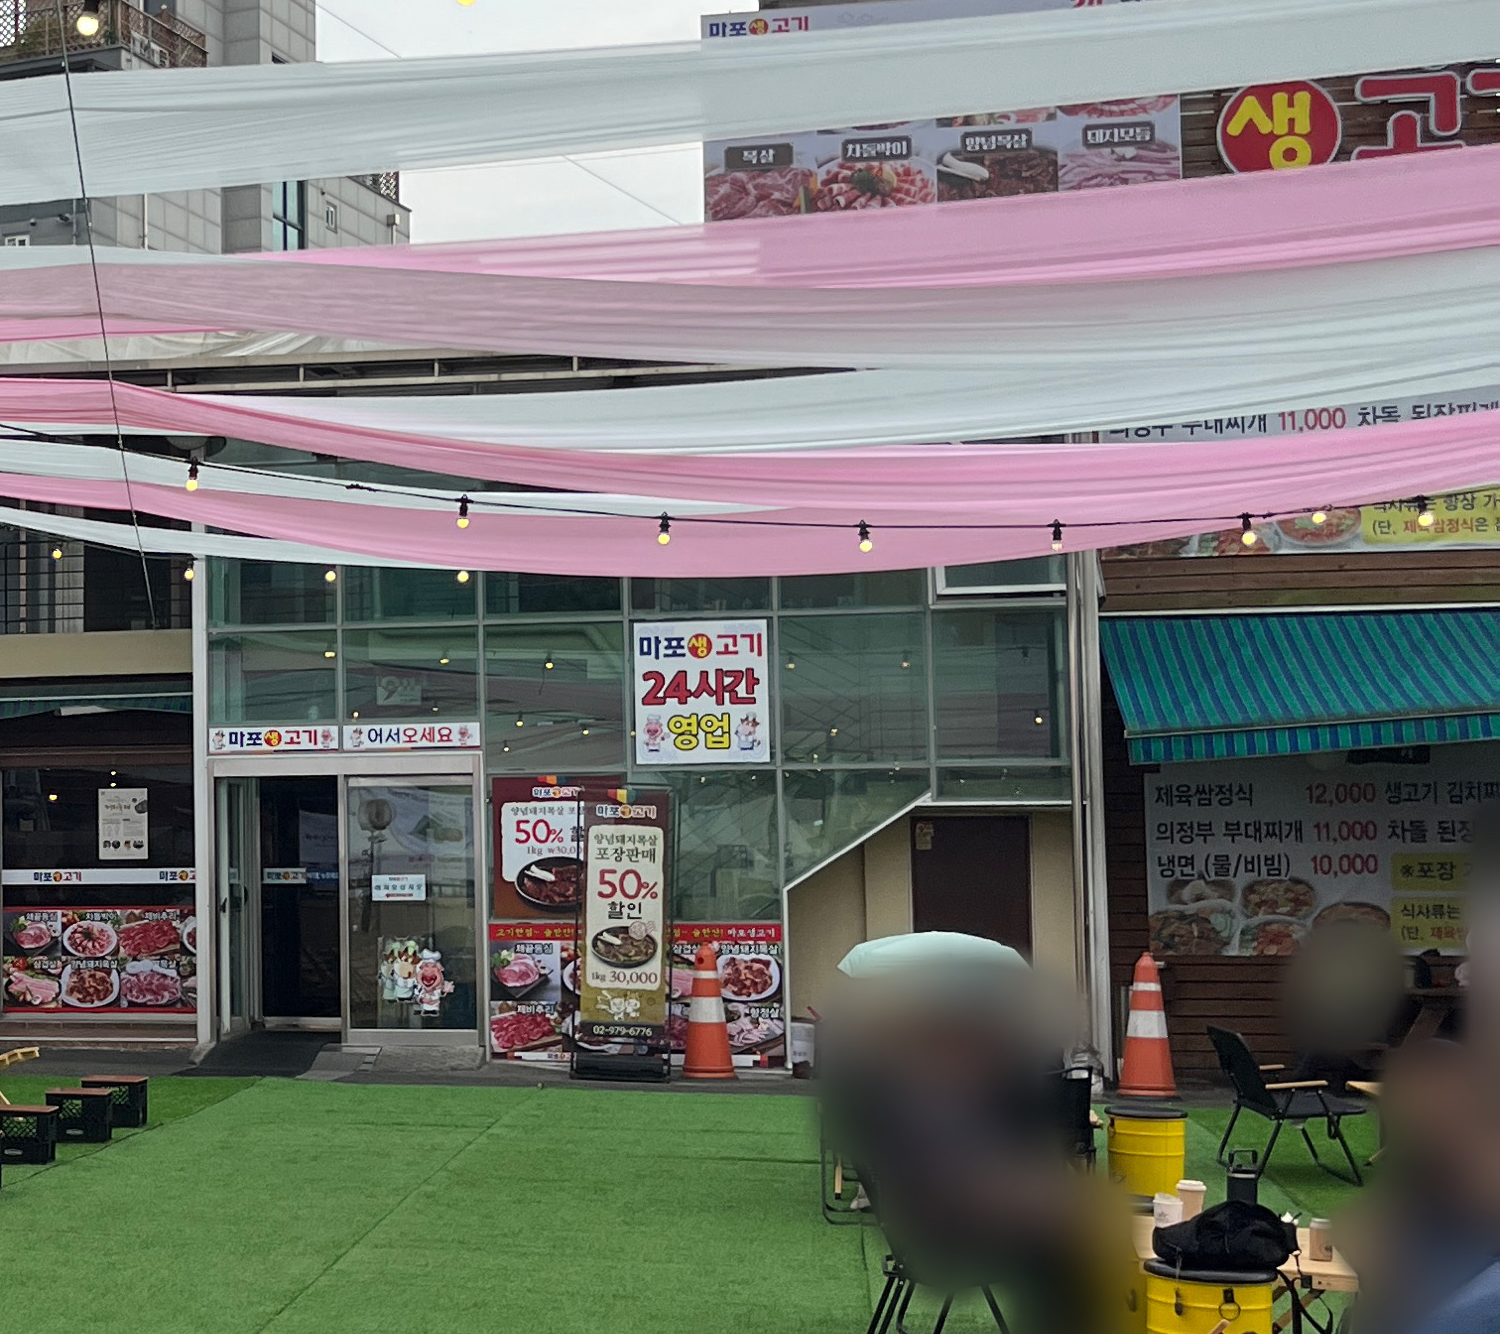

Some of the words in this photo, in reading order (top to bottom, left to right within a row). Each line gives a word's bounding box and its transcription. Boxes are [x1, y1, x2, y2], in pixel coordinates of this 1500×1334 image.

[708, 15, 810, 38] 마포생고기
[845, 140, 908, 158] 차돌박이
[965, 133, 1029, 152] 양념목살
[742, 148, 776, 165] 목살
[1277, 407, 1347, 433] 11,000
[638, 632, 763, 660] 마포생고기
[641, 667, 761, 706] 24시간
[228, 729, 319, 748] 마포생고기
[367, 726, 454, 745] 어서오세요
[666, 711, 732, 752] 영업
[1154, 781, 1254, 808] 제육쌈정식
[1304, 782, 1377, 808] 12,000
[1384, 780, 1439, 805] 생고기
[514, 818, 564, 845] 50%
[593, 833, 659, 847] 양념돼지목살
[1155, 819, 1216, 845] 의정부
[1222, 819, 1304, 844] 부대찌개
[1312, 819, 1378, 845] 11,000
[1387, 819, 1428, 844] 차돌
[594, 847, 657, 864] 포장판매
[1157, 852, 1196, 879] 냉면
[1203, 852, 1292, 880] (물/비빔)
[1310, 852, 1379, 879] 10,000
[596, 868, 659, 900] 50%
[606, 901, 643, 921] 할인
[608, 970, 658, 986] 30,000
[592, 1024, 653, 1037] 02-979-6776
